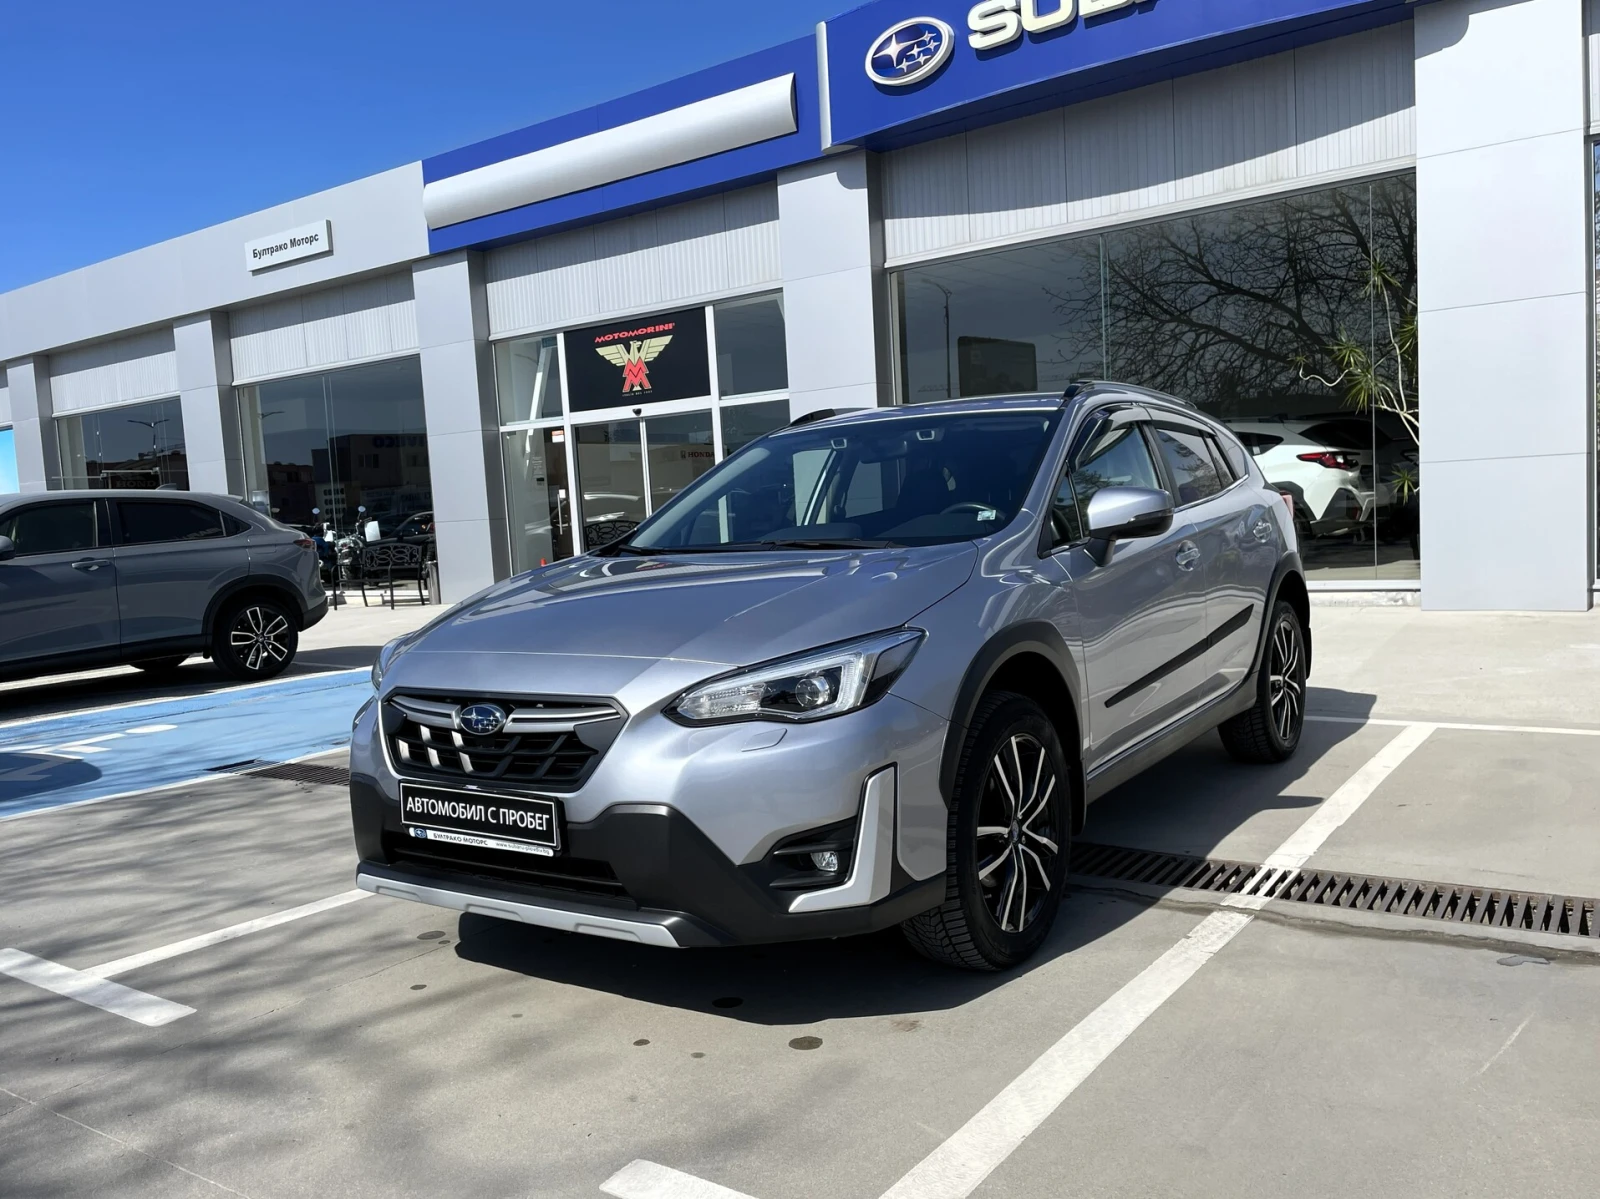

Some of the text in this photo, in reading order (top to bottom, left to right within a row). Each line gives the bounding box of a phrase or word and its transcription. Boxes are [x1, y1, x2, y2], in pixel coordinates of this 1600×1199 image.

[967, 0, 1148, 50] SU
[252, 233, 319, 260] Бултрако Моторс
[406, 796, 550, 831] АВТОМОБИЛ С ПРОБЕГ
[433, 832, 488, 846] БУЛТРАКО МОТОРС
